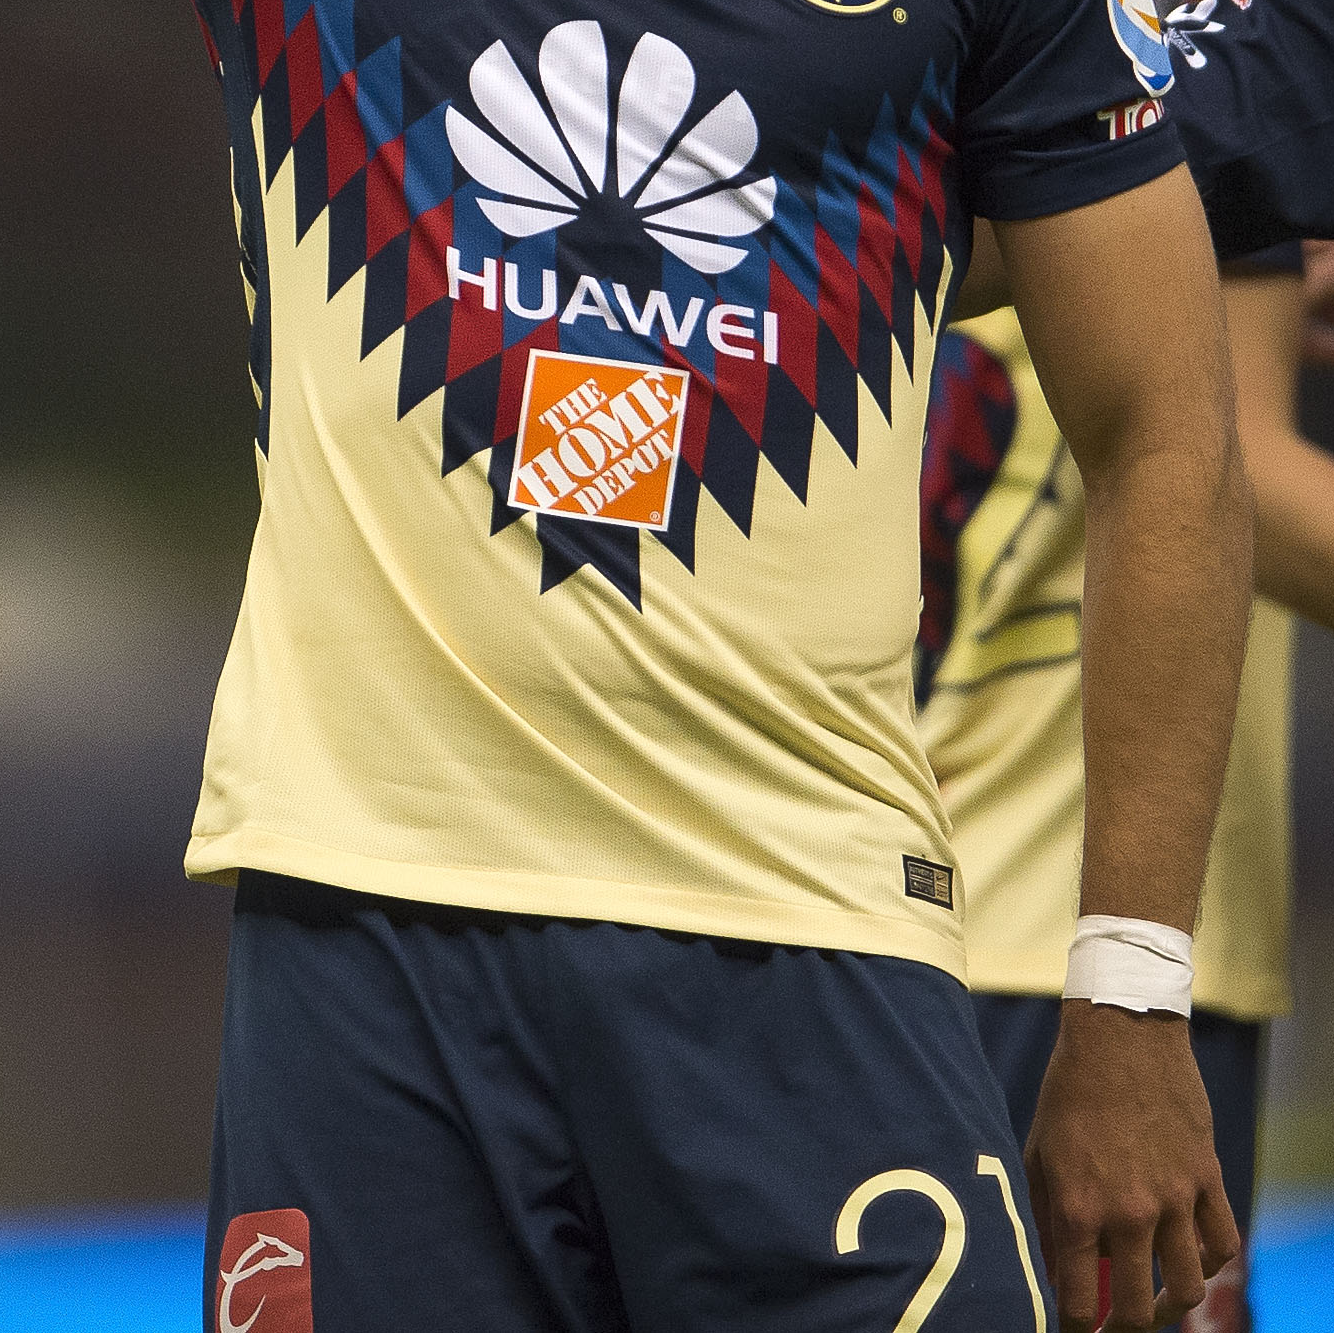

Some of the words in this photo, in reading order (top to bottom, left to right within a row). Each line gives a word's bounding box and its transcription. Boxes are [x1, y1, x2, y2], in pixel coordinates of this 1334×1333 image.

[445, 245, 779, 365] HUAWEI
[518, 370, 682, 509] HOME
[539, 377, 609, 436] THE
[572, 429, 677, 516] DEPOT
[836, 1154, 1046, 1333] 21
